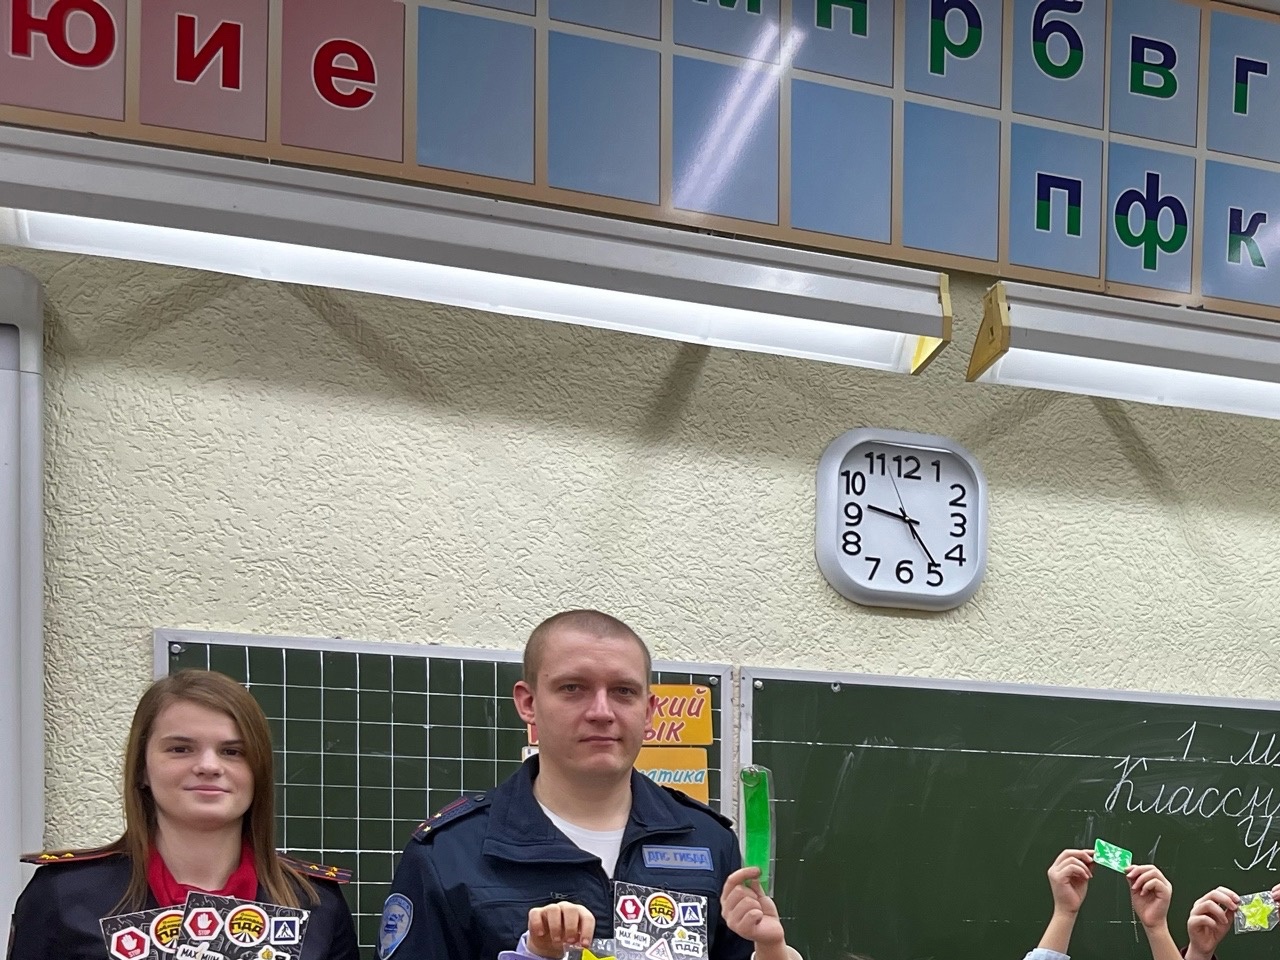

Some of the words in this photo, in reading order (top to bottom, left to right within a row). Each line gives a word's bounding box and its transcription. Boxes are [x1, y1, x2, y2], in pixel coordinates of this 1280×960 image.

[929, 0, 982, 75] р
[1032, 0, 1084, 79] б
[312, 39, 377, 109] е
[1114, 172, 1188, 271] ф
[865, 452, 885, 476] 11
[893, 455, 921, 480] 12
[931, 460, 940, 482] 1
[841, 470, 866, 496] 10
[949, 484, 967, 508] 2
[844, 502, 863, 527] 9
[950, 513, 967, 537] 3
[842, 531, 861, 556] 8
[944, 544, 966, 566] 4
[865, 557, 881, 580] 7
[895, 560, 914, 584] 6
[926, 562, 944, 587] 5
[641, 769, 705, 783] атика
[231, 922, 263, 934] ПДД
